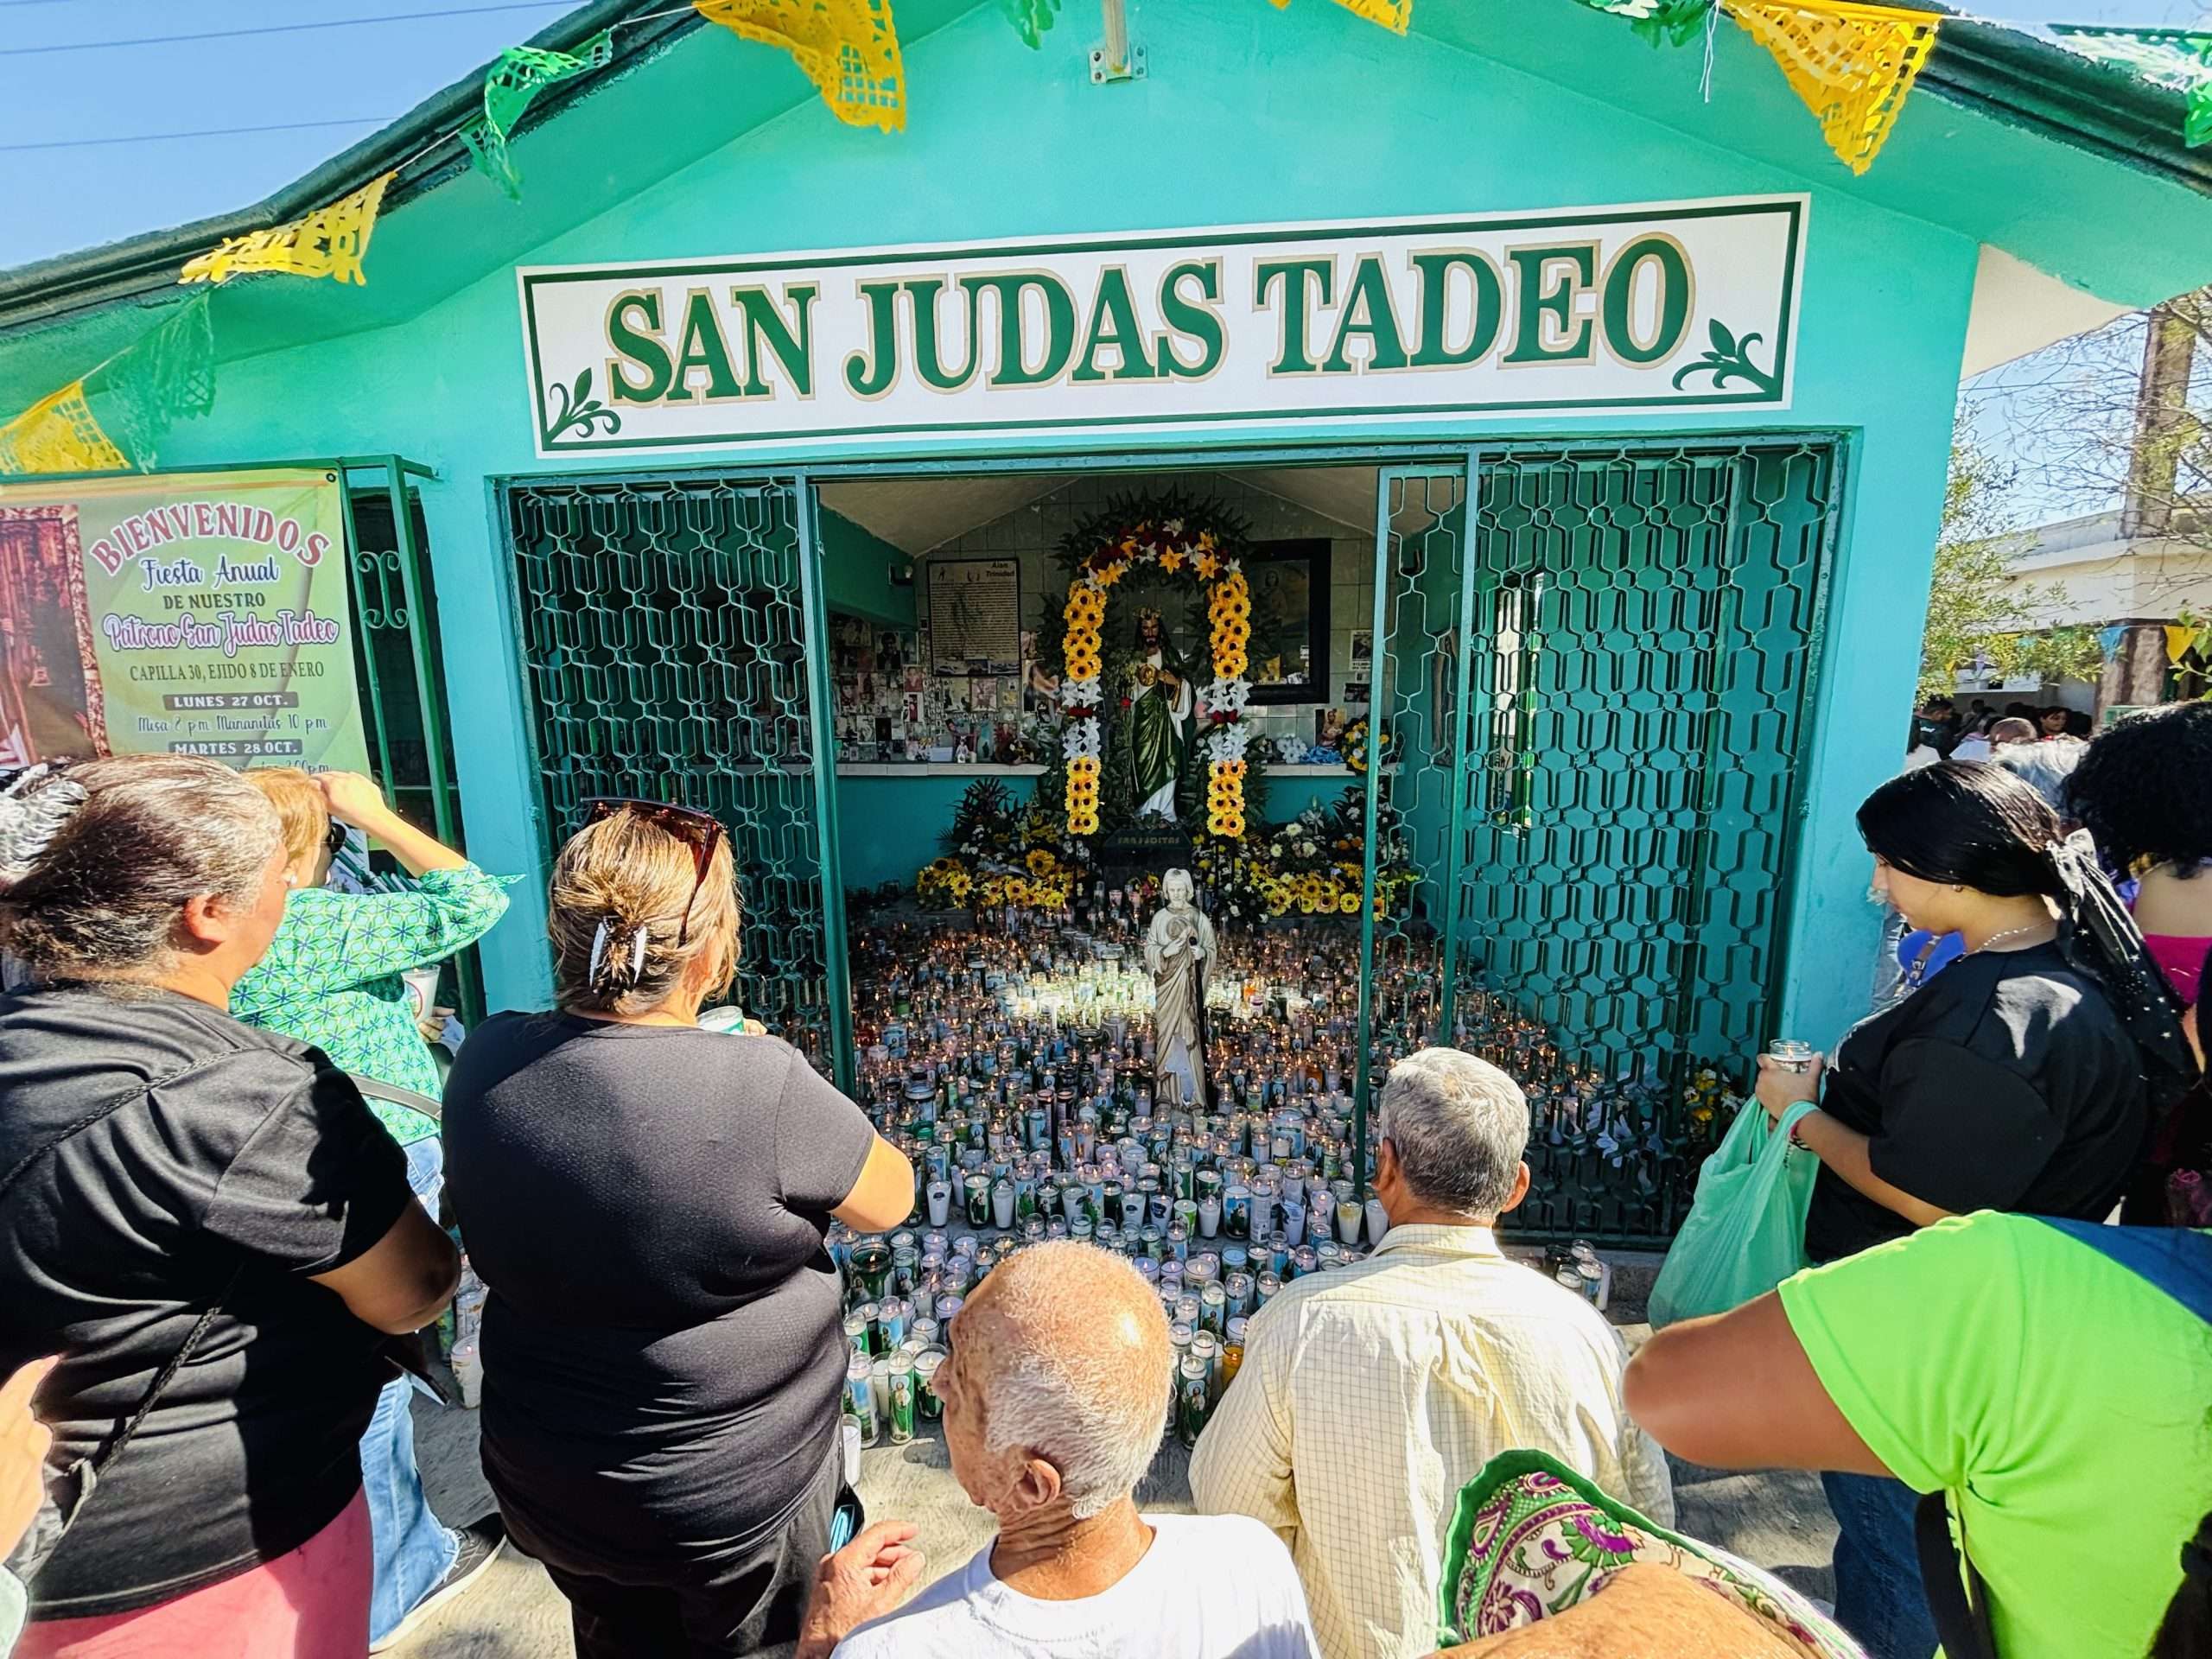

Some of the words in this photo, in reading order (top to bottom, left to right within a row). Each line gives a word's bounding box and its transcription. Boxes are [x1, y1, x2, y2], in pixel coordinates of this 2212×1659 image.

[605, 280, 821, 407] SAN
[842, 255, 1228, 402] JUDAS
[1251, 230, 1695, 378] TADEO
[91, 502, 331, 575] BIENVENIDOS
[141, 558, 202, 591] Fiesta
[215, 556, 278, 588] Anual
[163, 594, 183, 609] DE
[189, 592, 265, 609] NUESTRO
[105, 614, 181, 651] Patrono
[181, 613, 221, 648] San
[219, 611, 282, 656] Judas
[278, 609, 338, 645] Tadeo
[130, 664, 187, 681] CAPILLA
[188, 664, 206, 682] 30,
[209, 664, 247, 679] EJIDO
[251, 664, 257, 678] 8
[259, 663, 277, 678] DE
[281, 661, 324, 677] ENERO
[174, 695, 225, 708] LUNES
[232, 696, 247, 707] 27
[253, 694, 289, 706] OCT.
[138, 716, 168, 732] Misa
[289, 714, 299, 728] 10
[175, 742, 237, 754] MARTES
[244, 743, 260, 754] 28
[264, 741, 298, 753] OCT.
